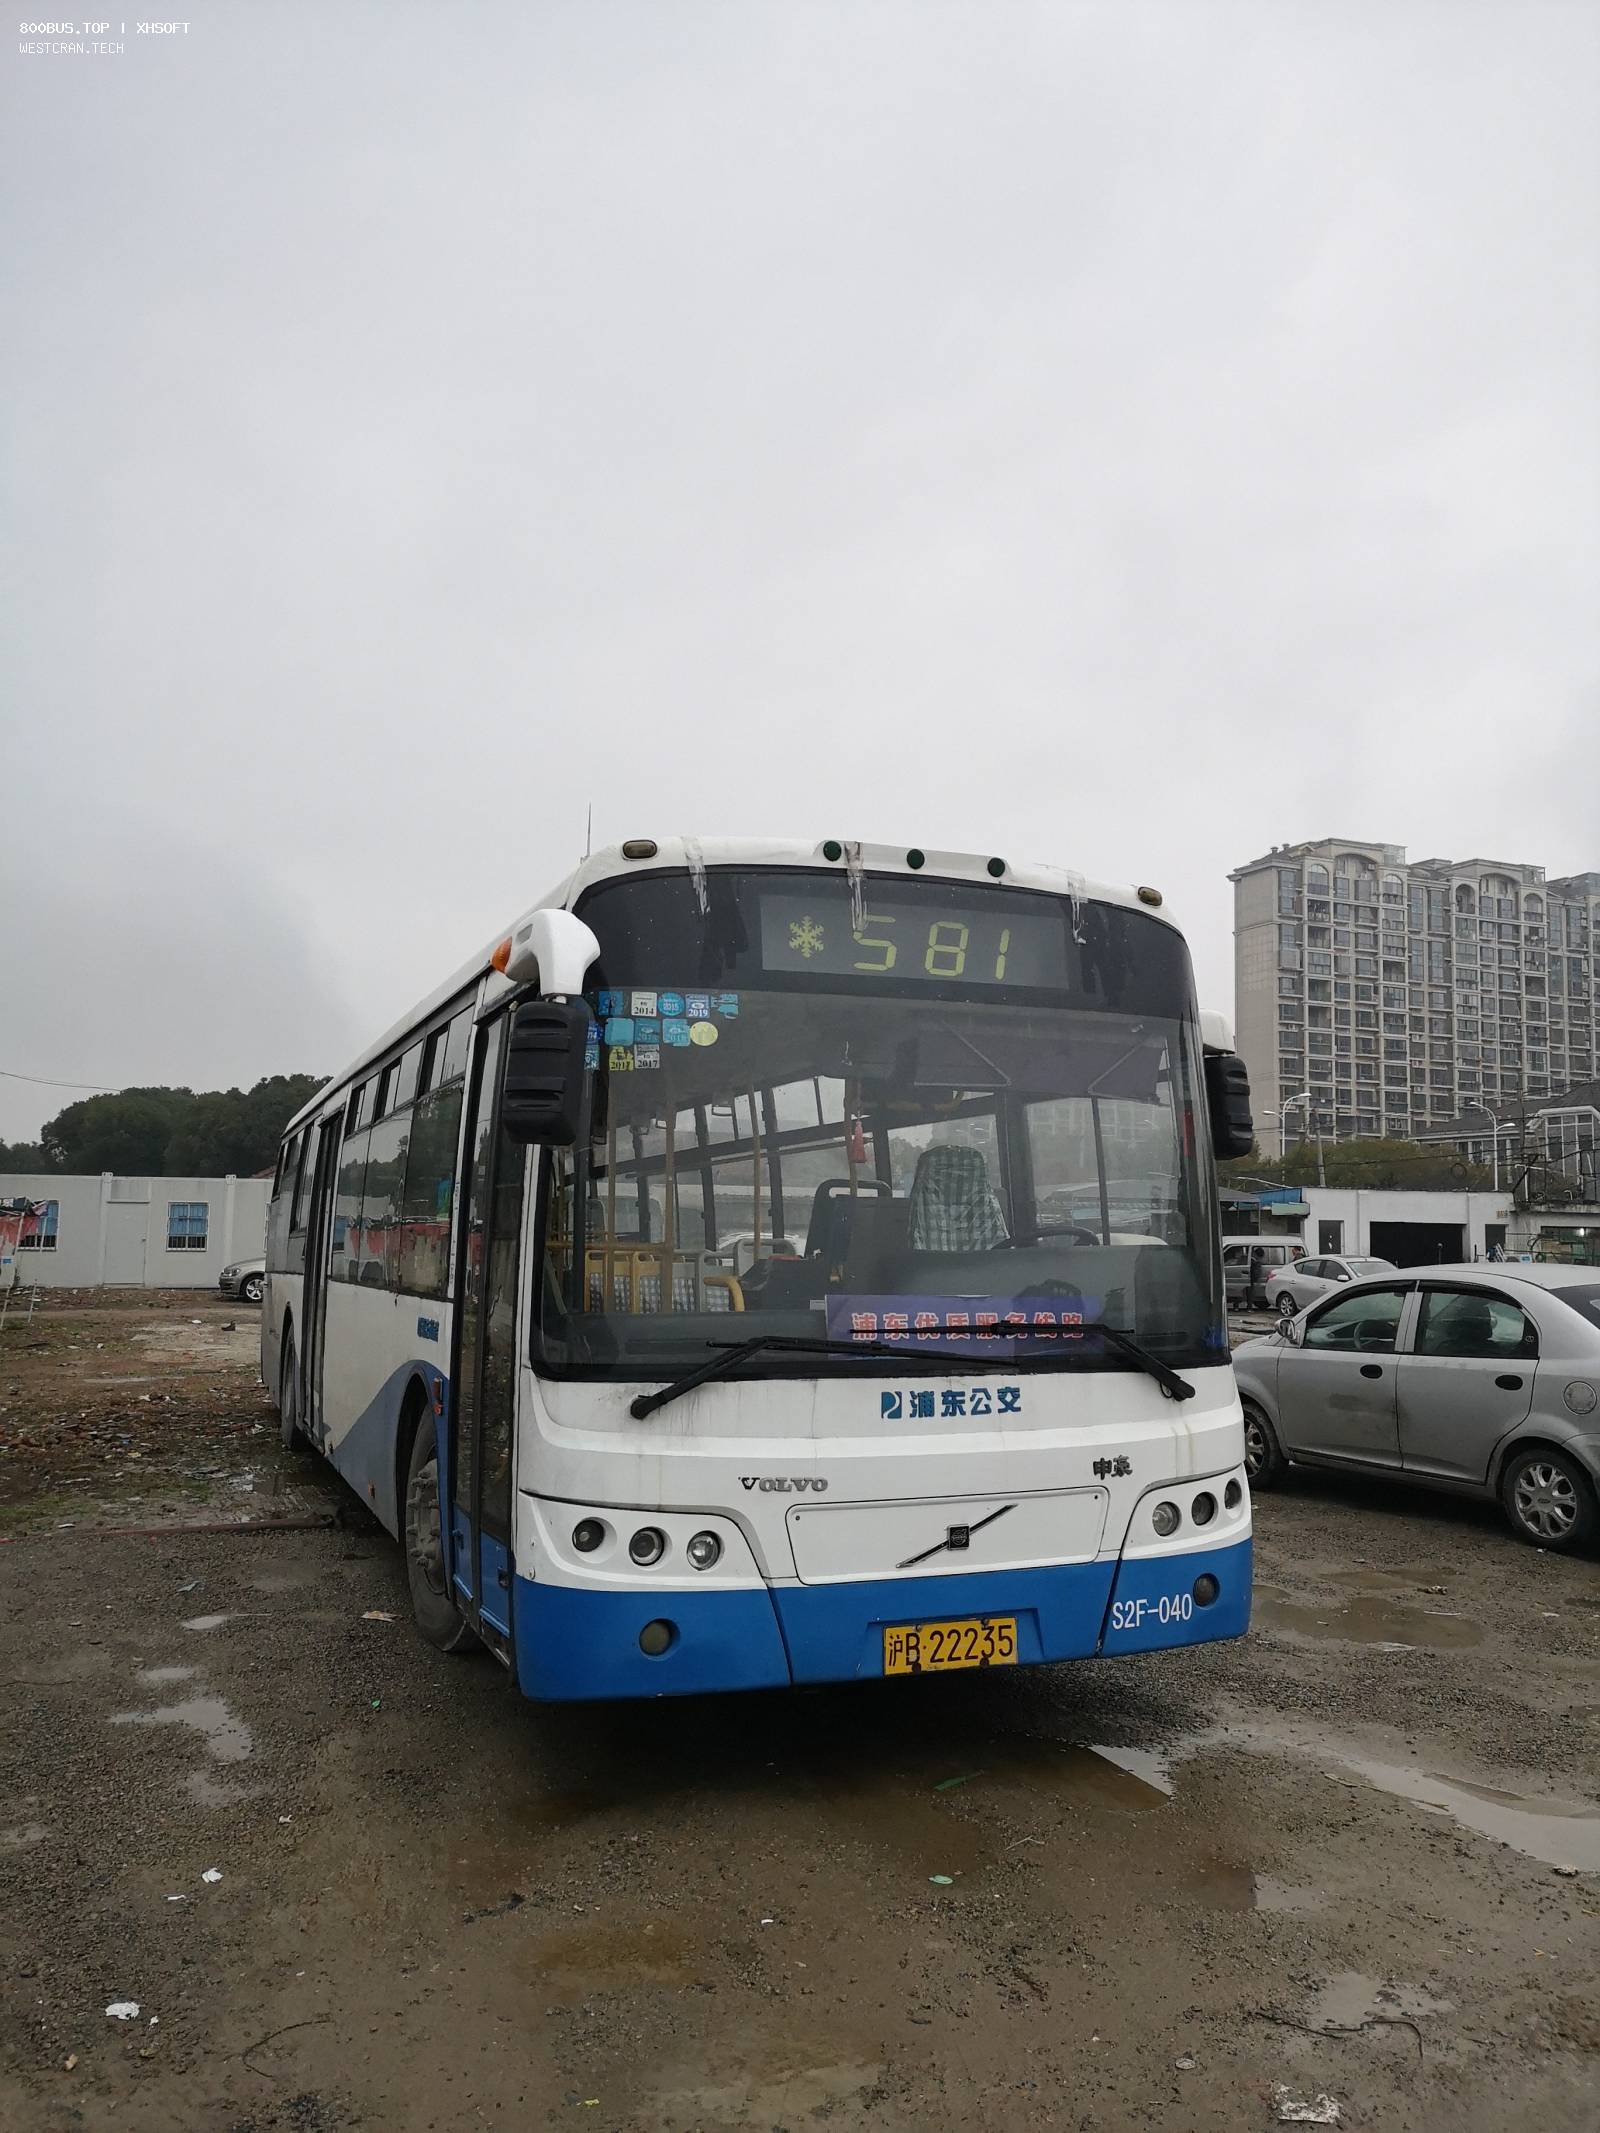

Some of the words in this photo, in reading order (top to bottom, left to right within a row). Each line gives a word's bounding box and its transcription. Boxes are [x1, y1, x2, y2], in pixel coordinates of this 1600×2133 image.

[853, 915, 1010, 980] 581
[634, 1007, 654, 1015] 2014
[688, 1008, 708, 1017] 2019
[638, 1060, 658, 1068] 2017
[909, 1387, 1022, 1418] 浦东公交
[739, 1477, 828, 1492] VOLVO
[1112, 1594, 1192, 1630] S2F-040
